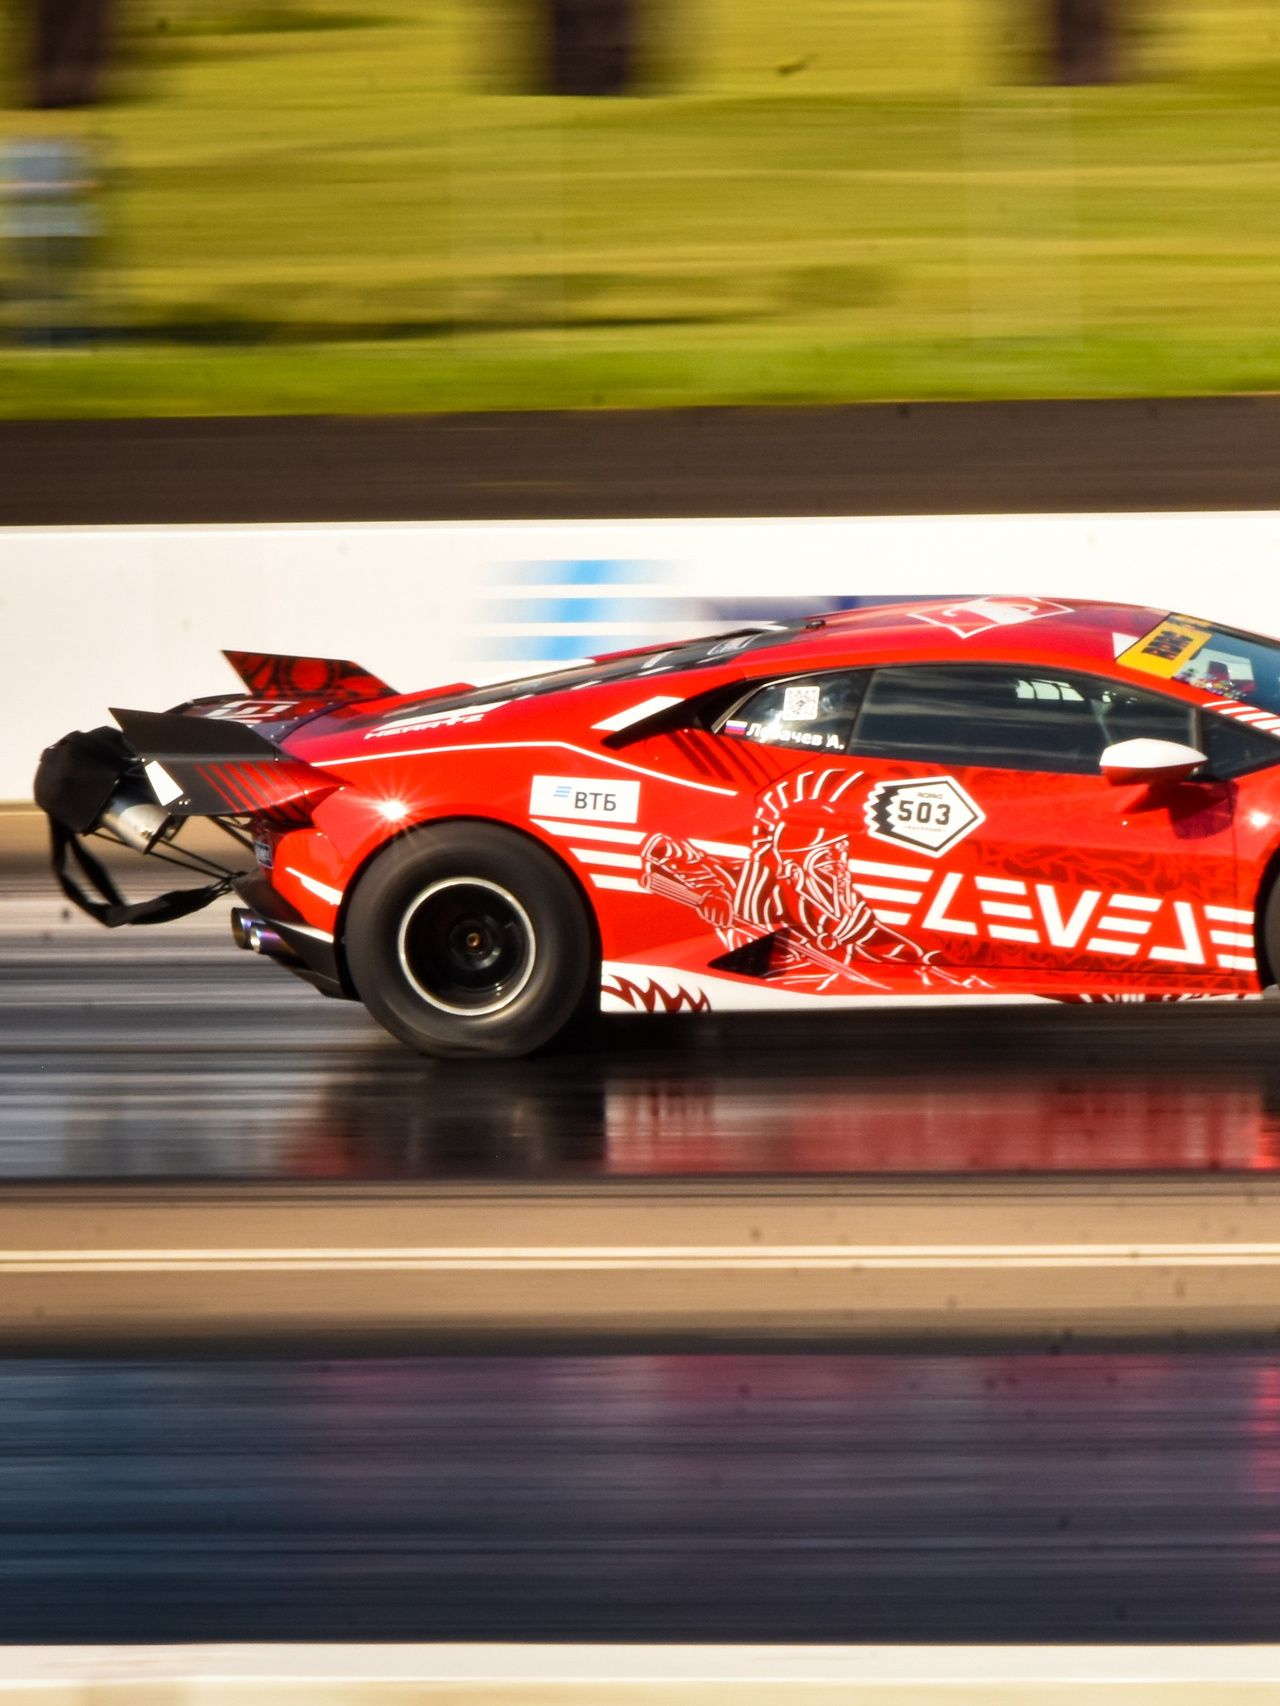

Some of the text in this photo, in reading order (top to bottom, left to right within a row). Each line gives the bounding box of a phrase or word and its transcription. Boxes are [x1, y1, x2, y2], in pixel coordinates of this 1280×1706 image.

[745, 722, 823, 746] Лоачев
[574, 791, 617, 812] ВТБ
[897, 799, 951, 826] 503
